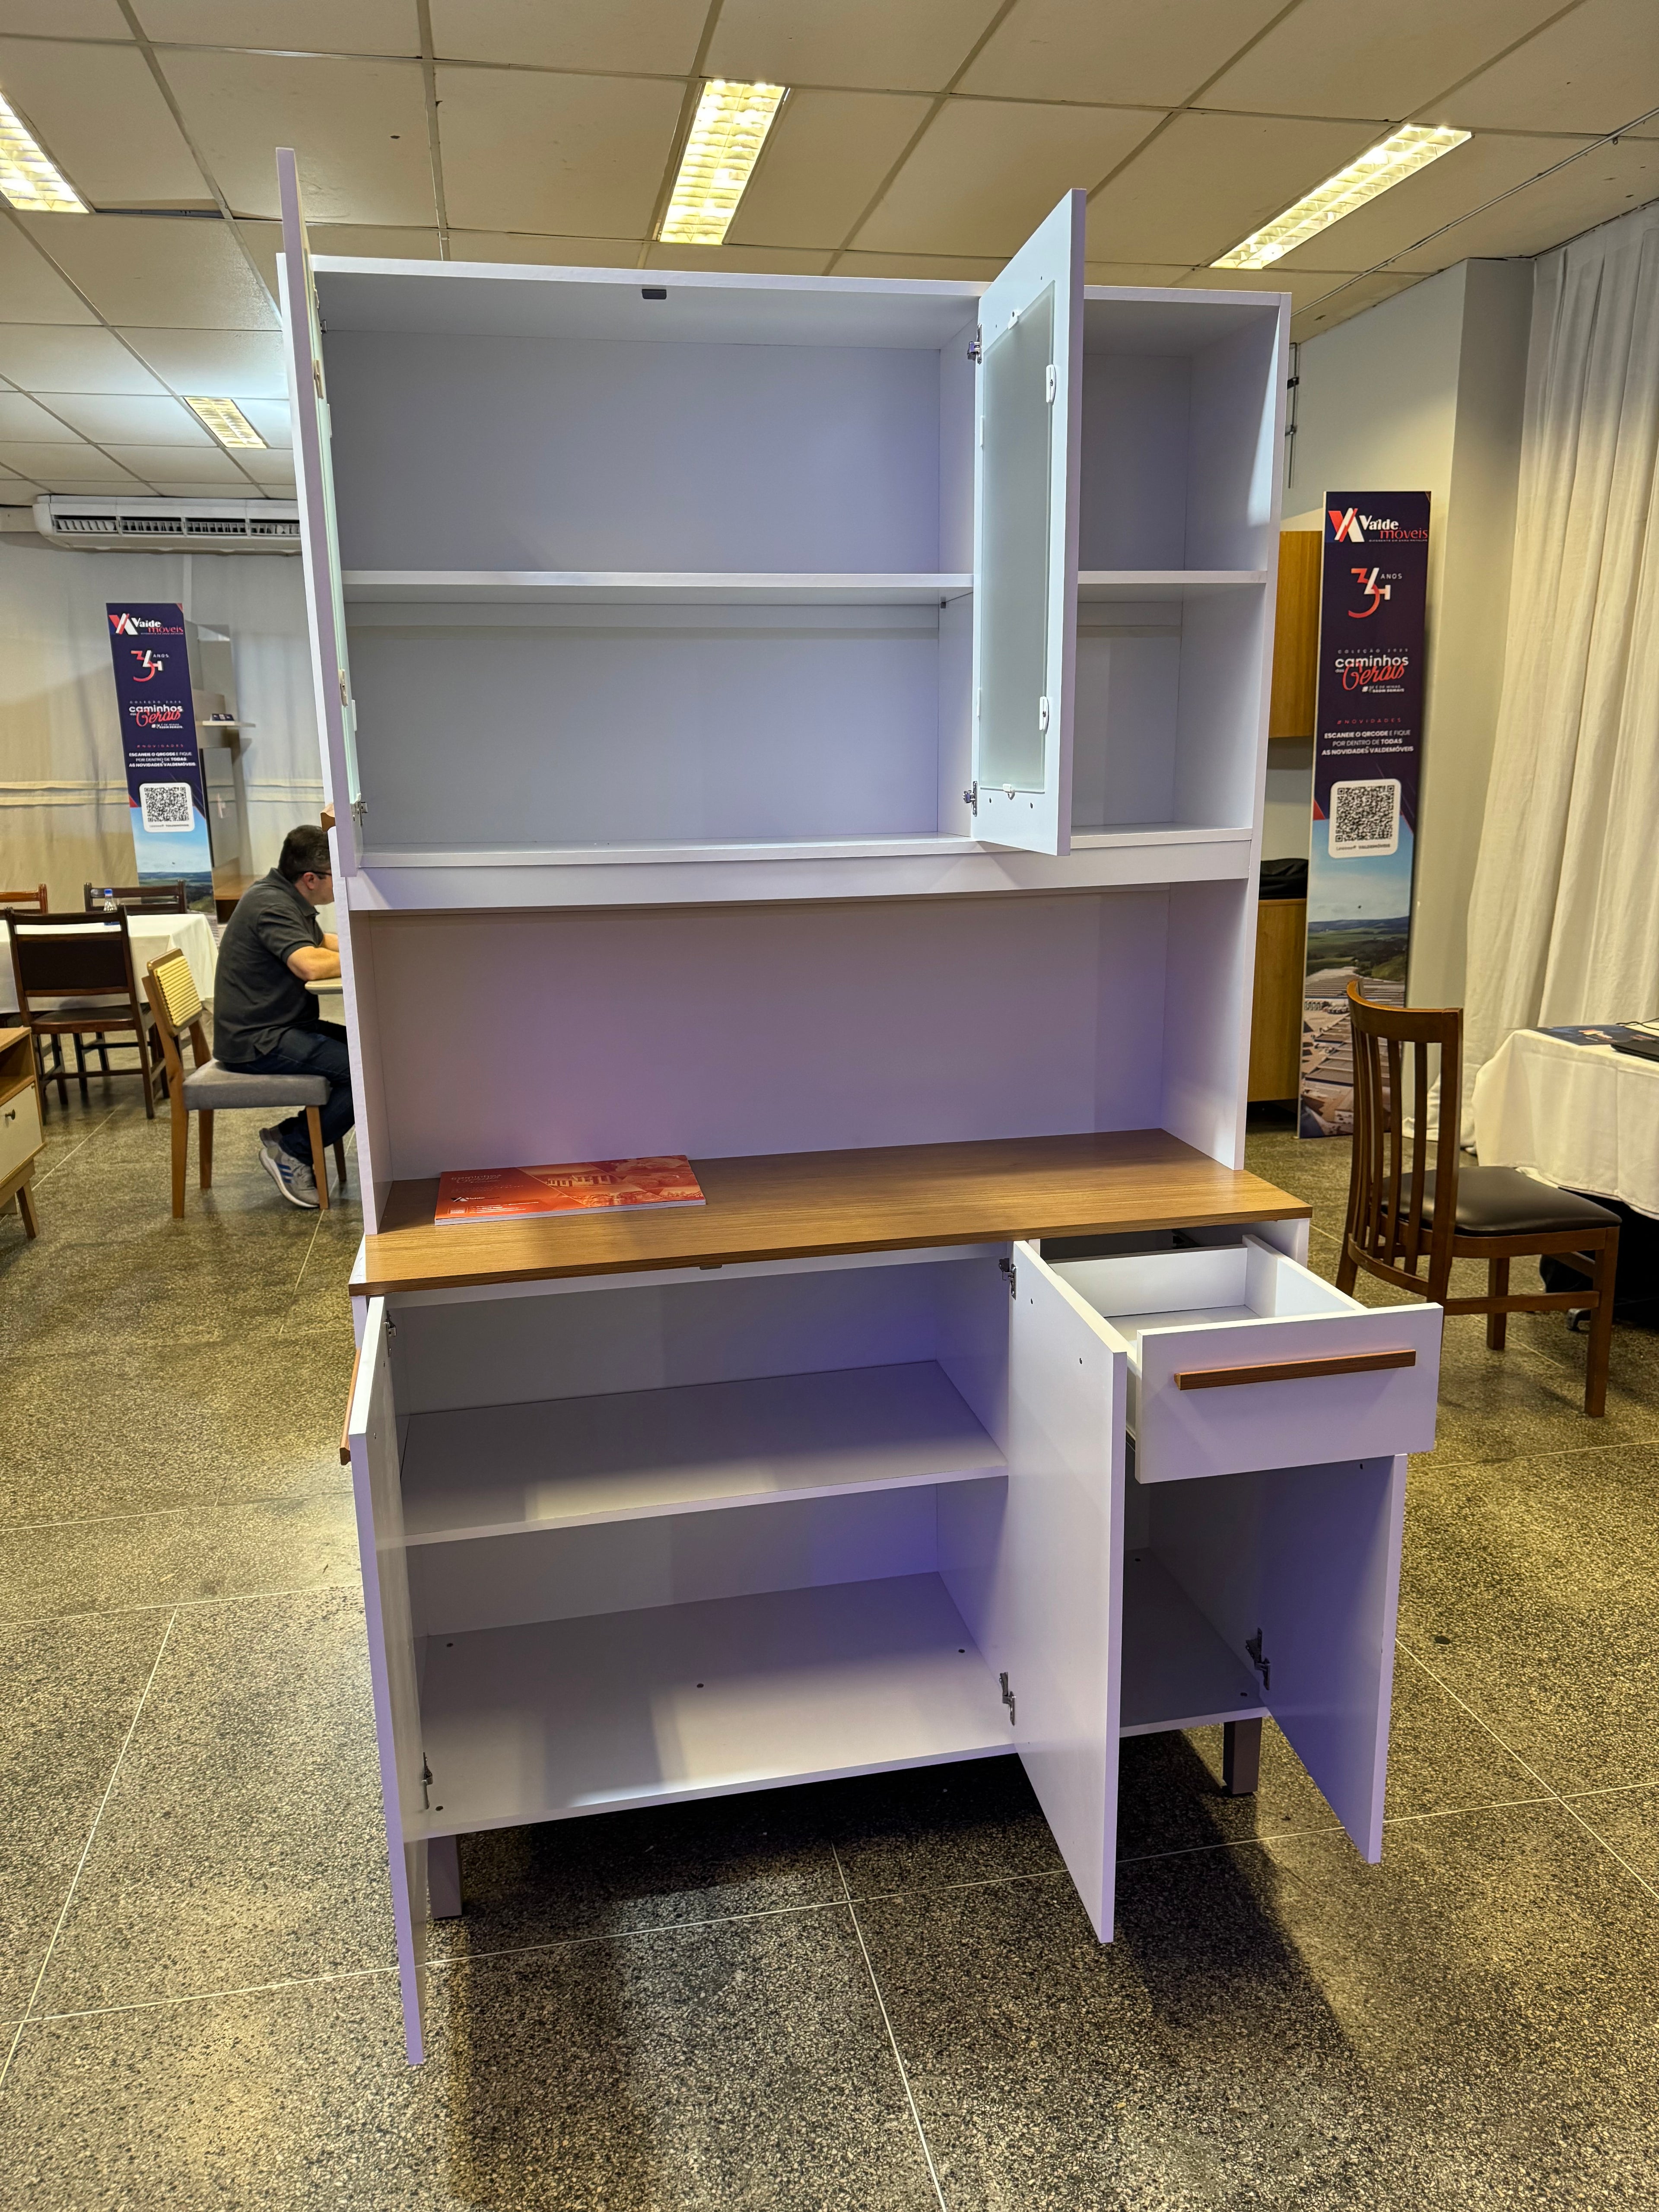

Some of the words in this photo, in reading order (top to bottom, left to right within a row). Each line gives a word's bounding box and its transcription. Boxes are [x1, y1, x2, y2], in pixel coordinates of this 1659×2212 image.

[1359, 515, 1399, 530] Valde
[1335, 655, 1409, 668] caminhos
[1342, 663, 1405, 690] Gerais
[129, 704, 183, 712] caminhos
[136, 710, 181, 727] Gerais
